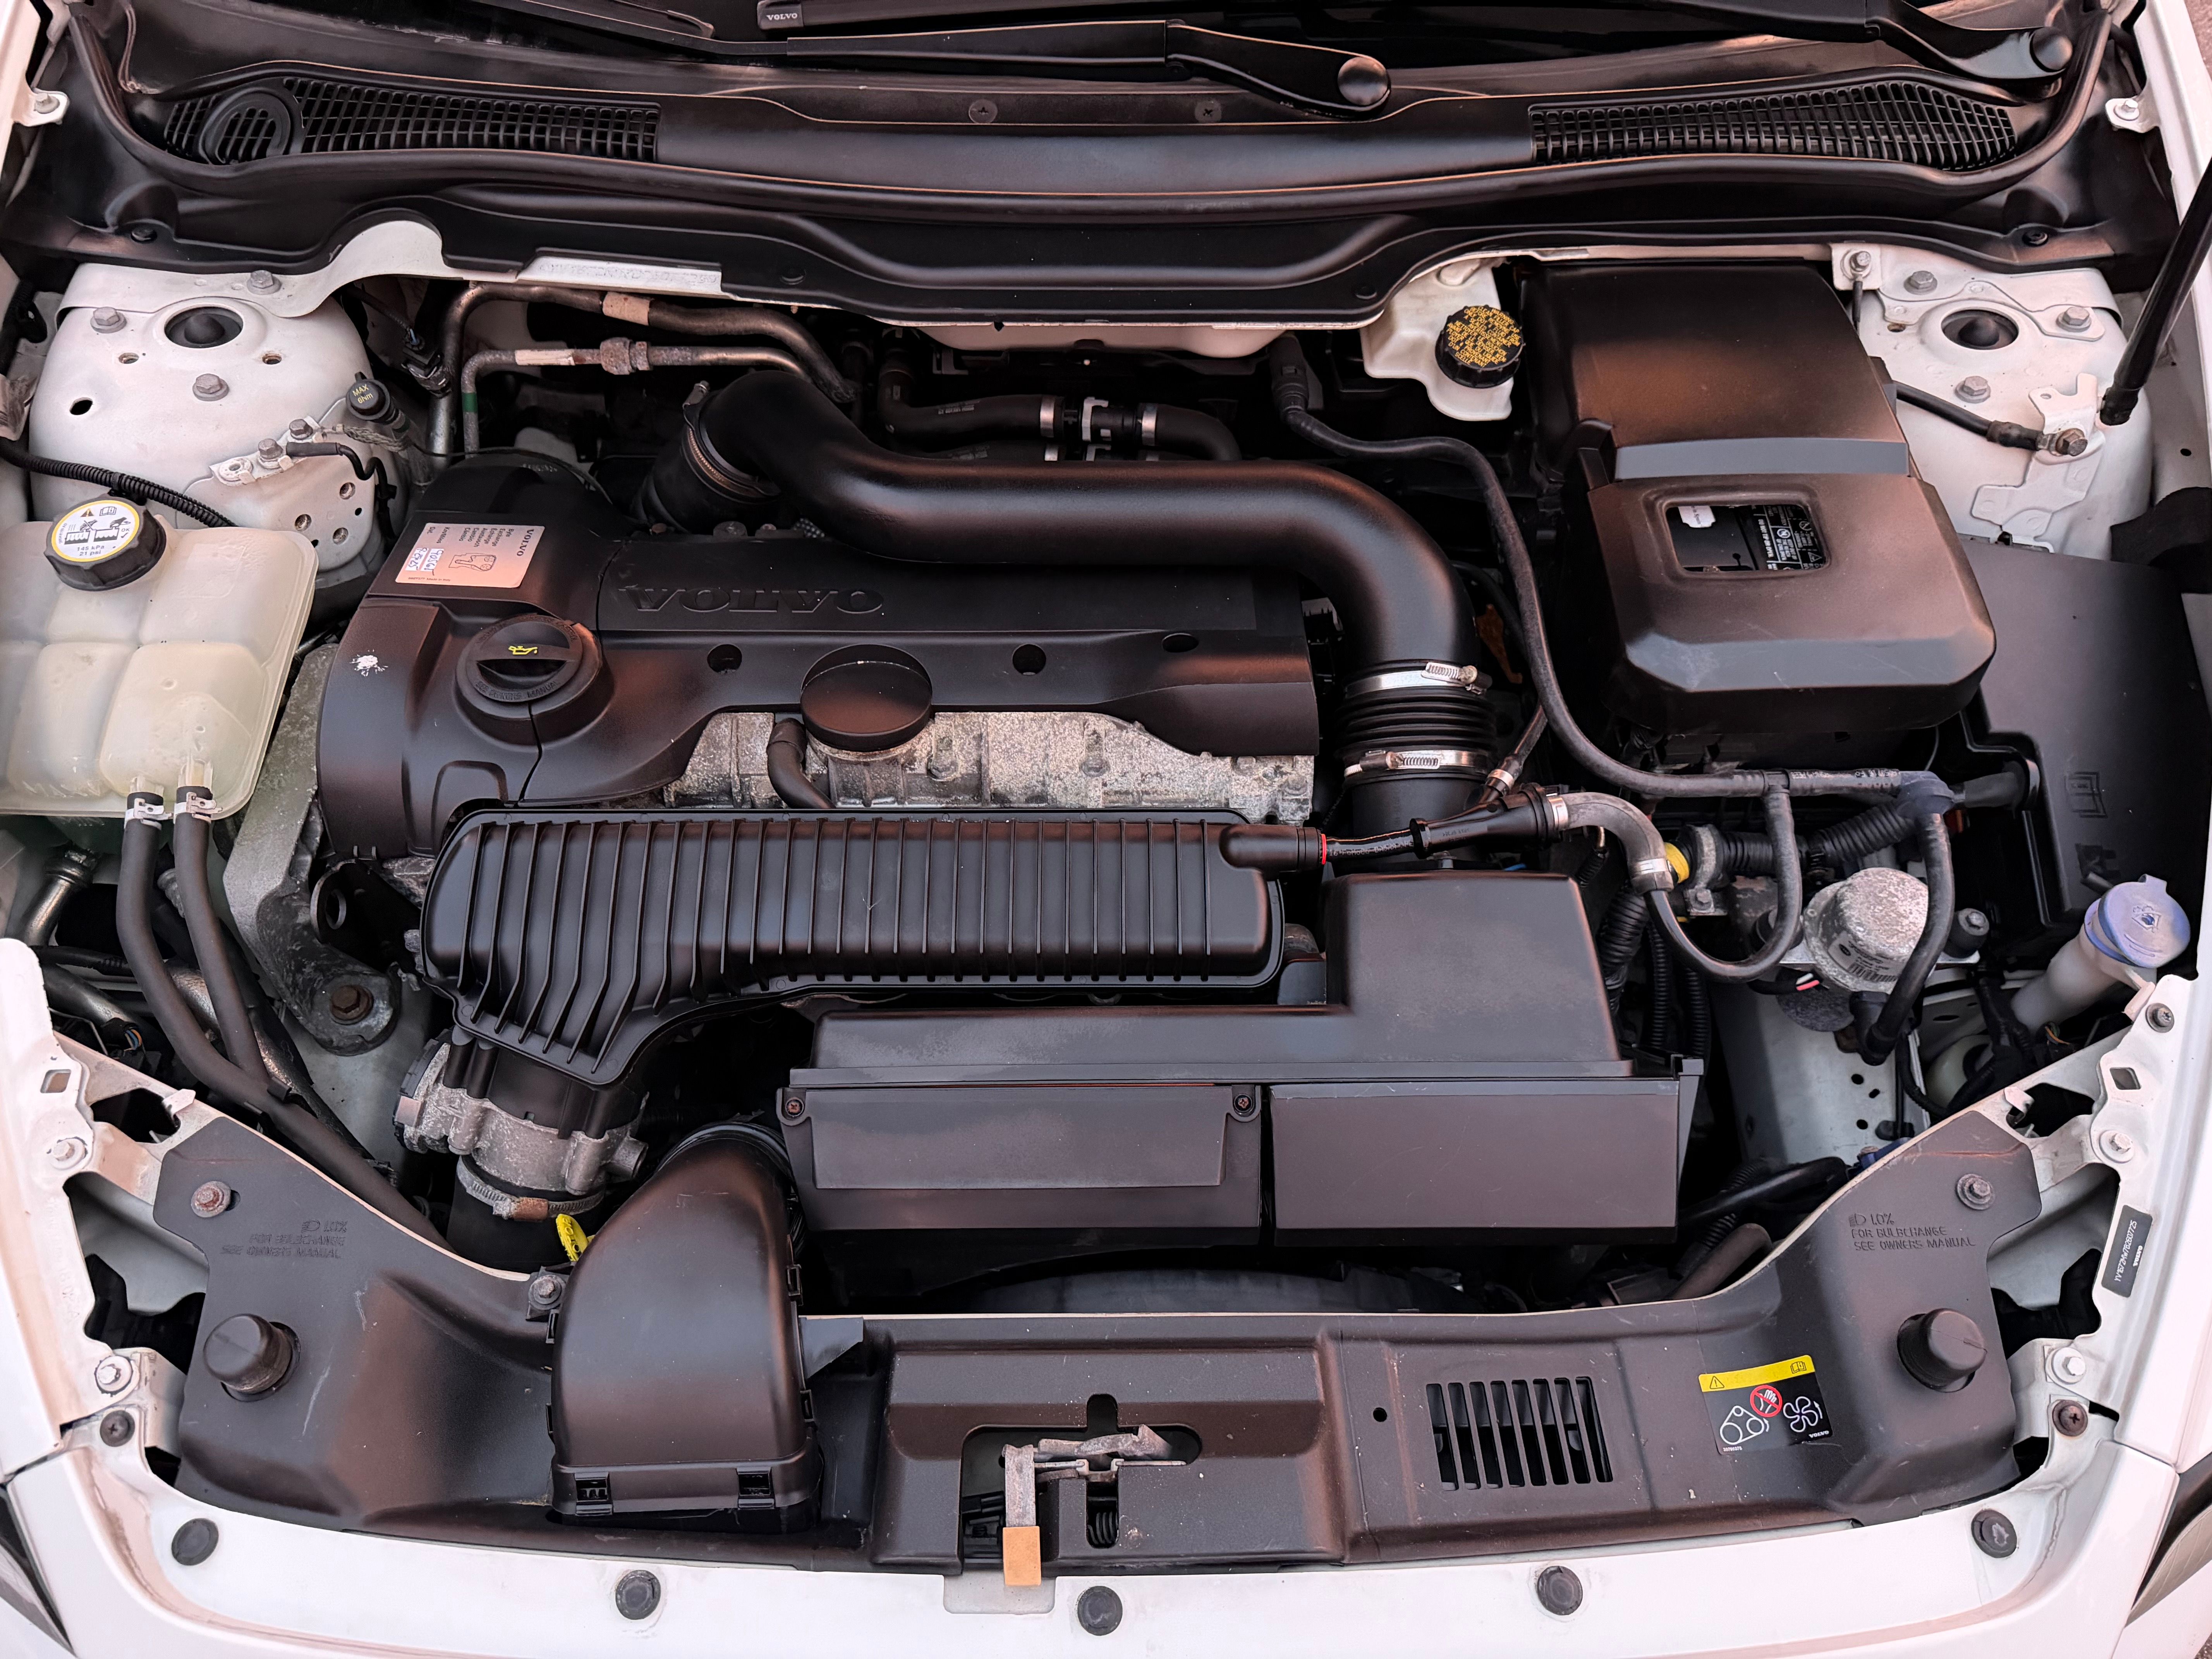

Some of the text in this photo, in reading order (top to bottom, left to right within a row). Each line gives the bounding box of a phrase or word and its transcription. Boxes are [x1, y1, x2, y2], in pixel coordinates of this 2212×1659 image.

[1470, 306, 1487, 319] BEFORE
[1511, 333, 1520, 341] USE
[1470, 318, 1487, 331] SEALED
[1478, 306, 1493, 317] CLEAN
[1493, 315, 1509, 327] FILLER
[1448, 323, 1462, 333] AVANT
[1464, 309, 1477, 318] ONLY
[1476, 317, 1487, 325] DOT
[1493, 327, 1506, 337] FLUID
[1506, 336, 1520, 346] FROM
[1448, 328, 1464, 340] PLOYER
[1465, 340, 1475, 348] QUE
[1483, 351, 1500, 364] LIQUIDE
[1455, 321, 1477, 337] NETTOYER
[1486, 341, 1506, 356] BOUCHON
[1449, 335, 1458, 343] DOT
[1464, 345, 1490, 364] PROVENANT
[1460, 349, 1486, 366] CONTENANT
[352, 384, 369, 397] MAX
[492, 528, 505, 547] Exchange
[516, 529, 535, 556] VOLVO
[618, 588, 884, 613] VOLVO
[1851, 1229, 1874, 1238] FOR
[1854, 1237, 1976, 1251] SEE OWNERS MANUAL
[2133, 1245, 2143, 1267] VOLVO
